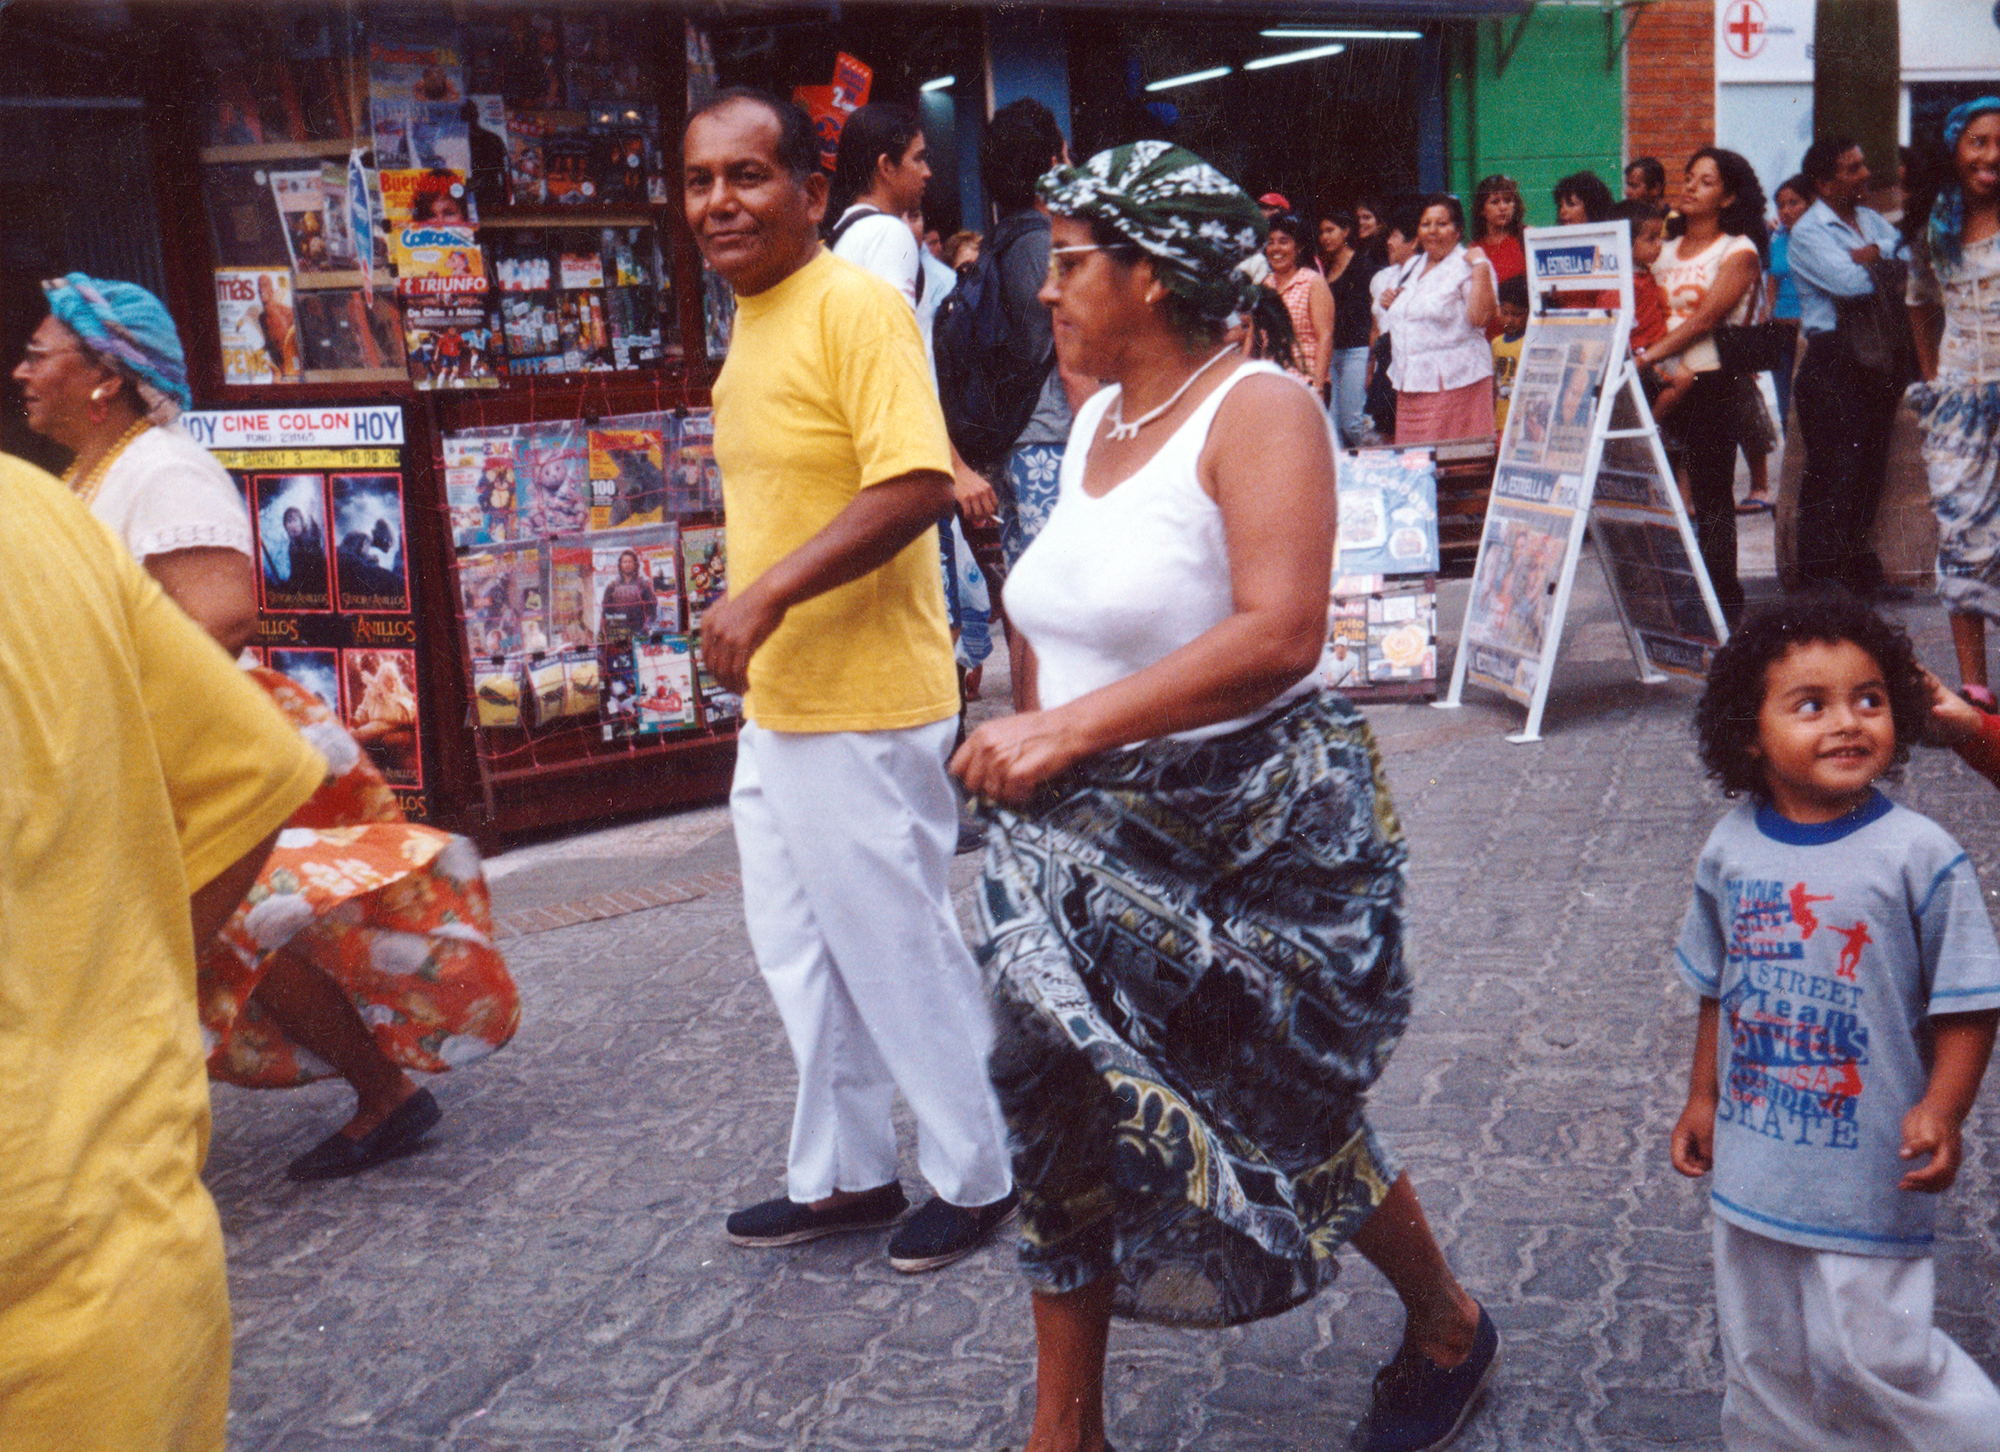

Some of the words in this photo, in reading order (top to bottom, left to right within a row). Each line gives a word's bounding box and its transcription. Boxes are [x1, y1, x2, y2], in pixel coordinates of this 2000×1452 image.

[1547, 254, 1584, 274] ESTRELLA
[420, 277, 487, 293] TRIUNFO
[183, 416, 217, 445] OY
[222, 414, 269, 432] CINE
[279, 412, 350, 430] COLON
[354, 411, 399, 441] HOY
[591, 479, 616, 495] 100
[258, 619, 299, 642] ILLOS
[355, 614, 416, 642] ANILLOS
[1757, 962, 1864, 1009] STREET
[1777, 1063, 1832, 1092] USA
